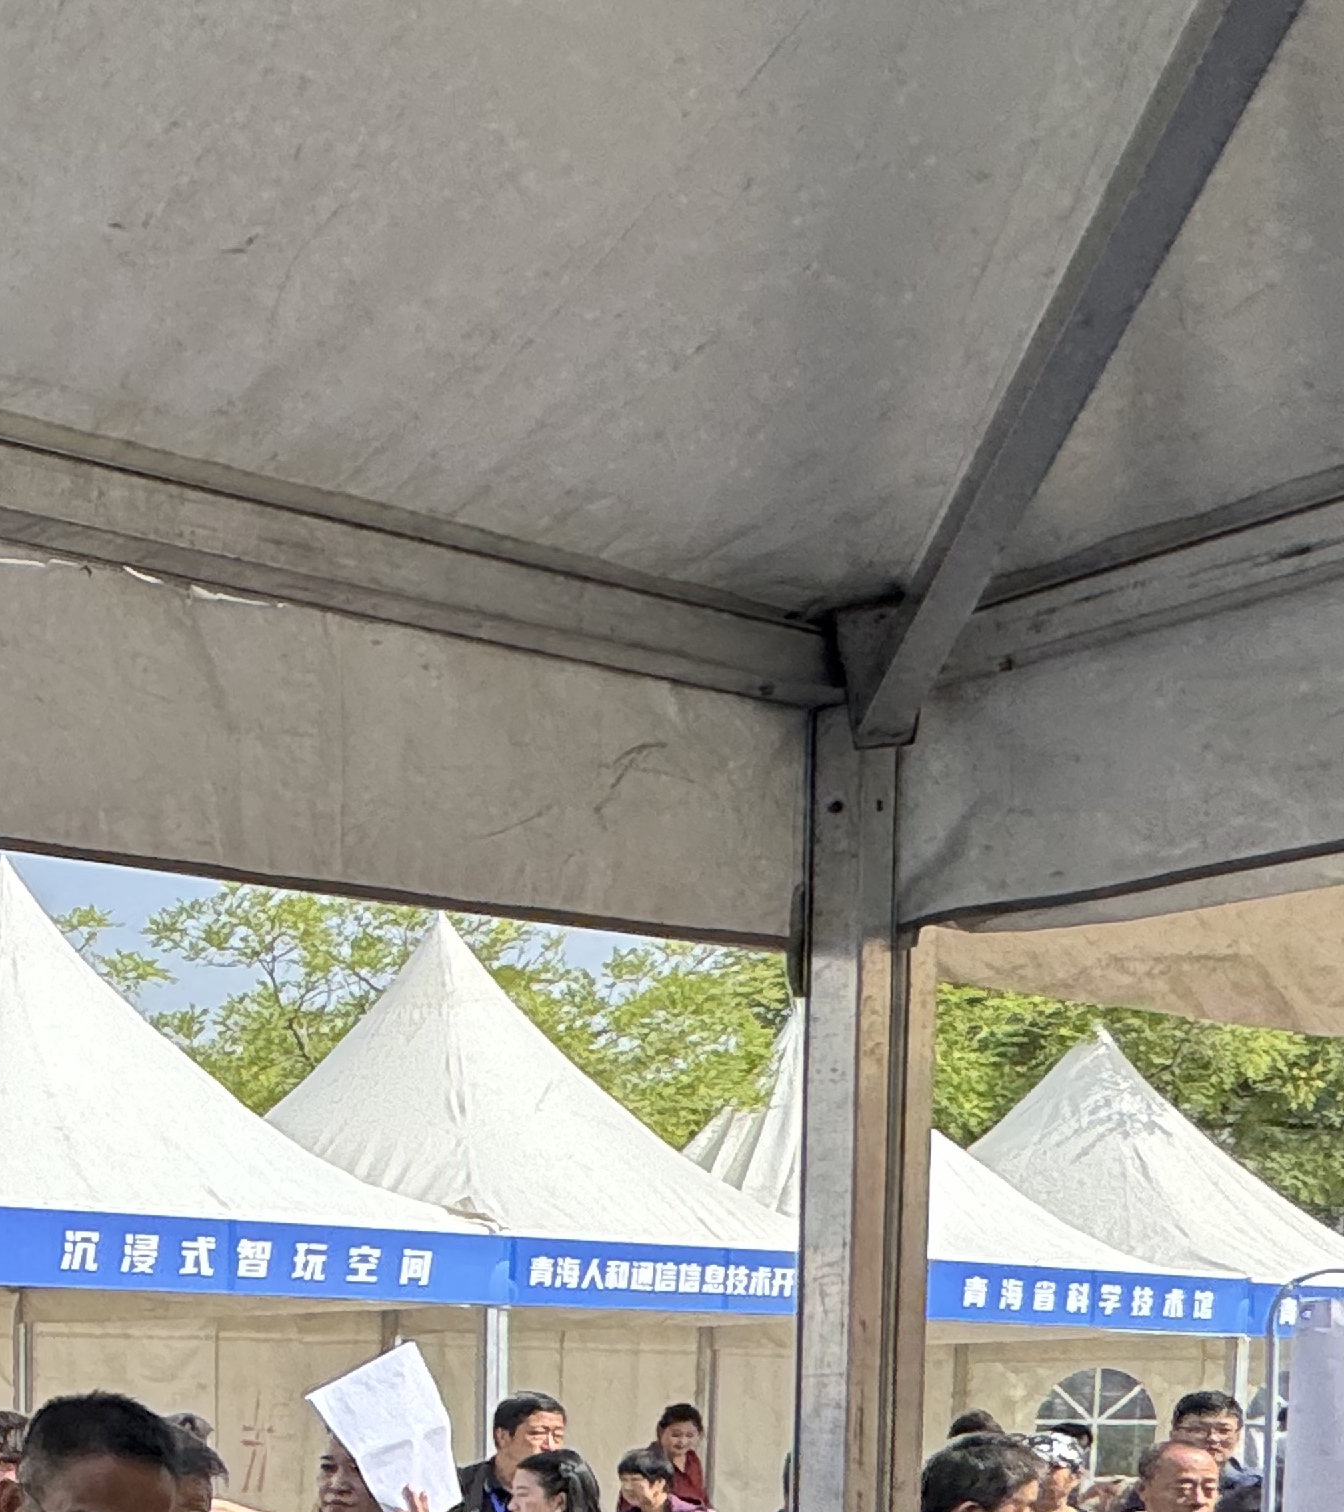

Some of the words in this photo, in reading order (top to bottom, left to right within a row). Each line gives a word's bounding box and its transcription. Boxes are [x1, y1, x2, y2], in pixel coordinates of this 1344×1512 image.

[60, 1229, 434, 1287] 沉浸式智玩空间
[962, 1275, 1216, 1321] 青海省科学技术馆
